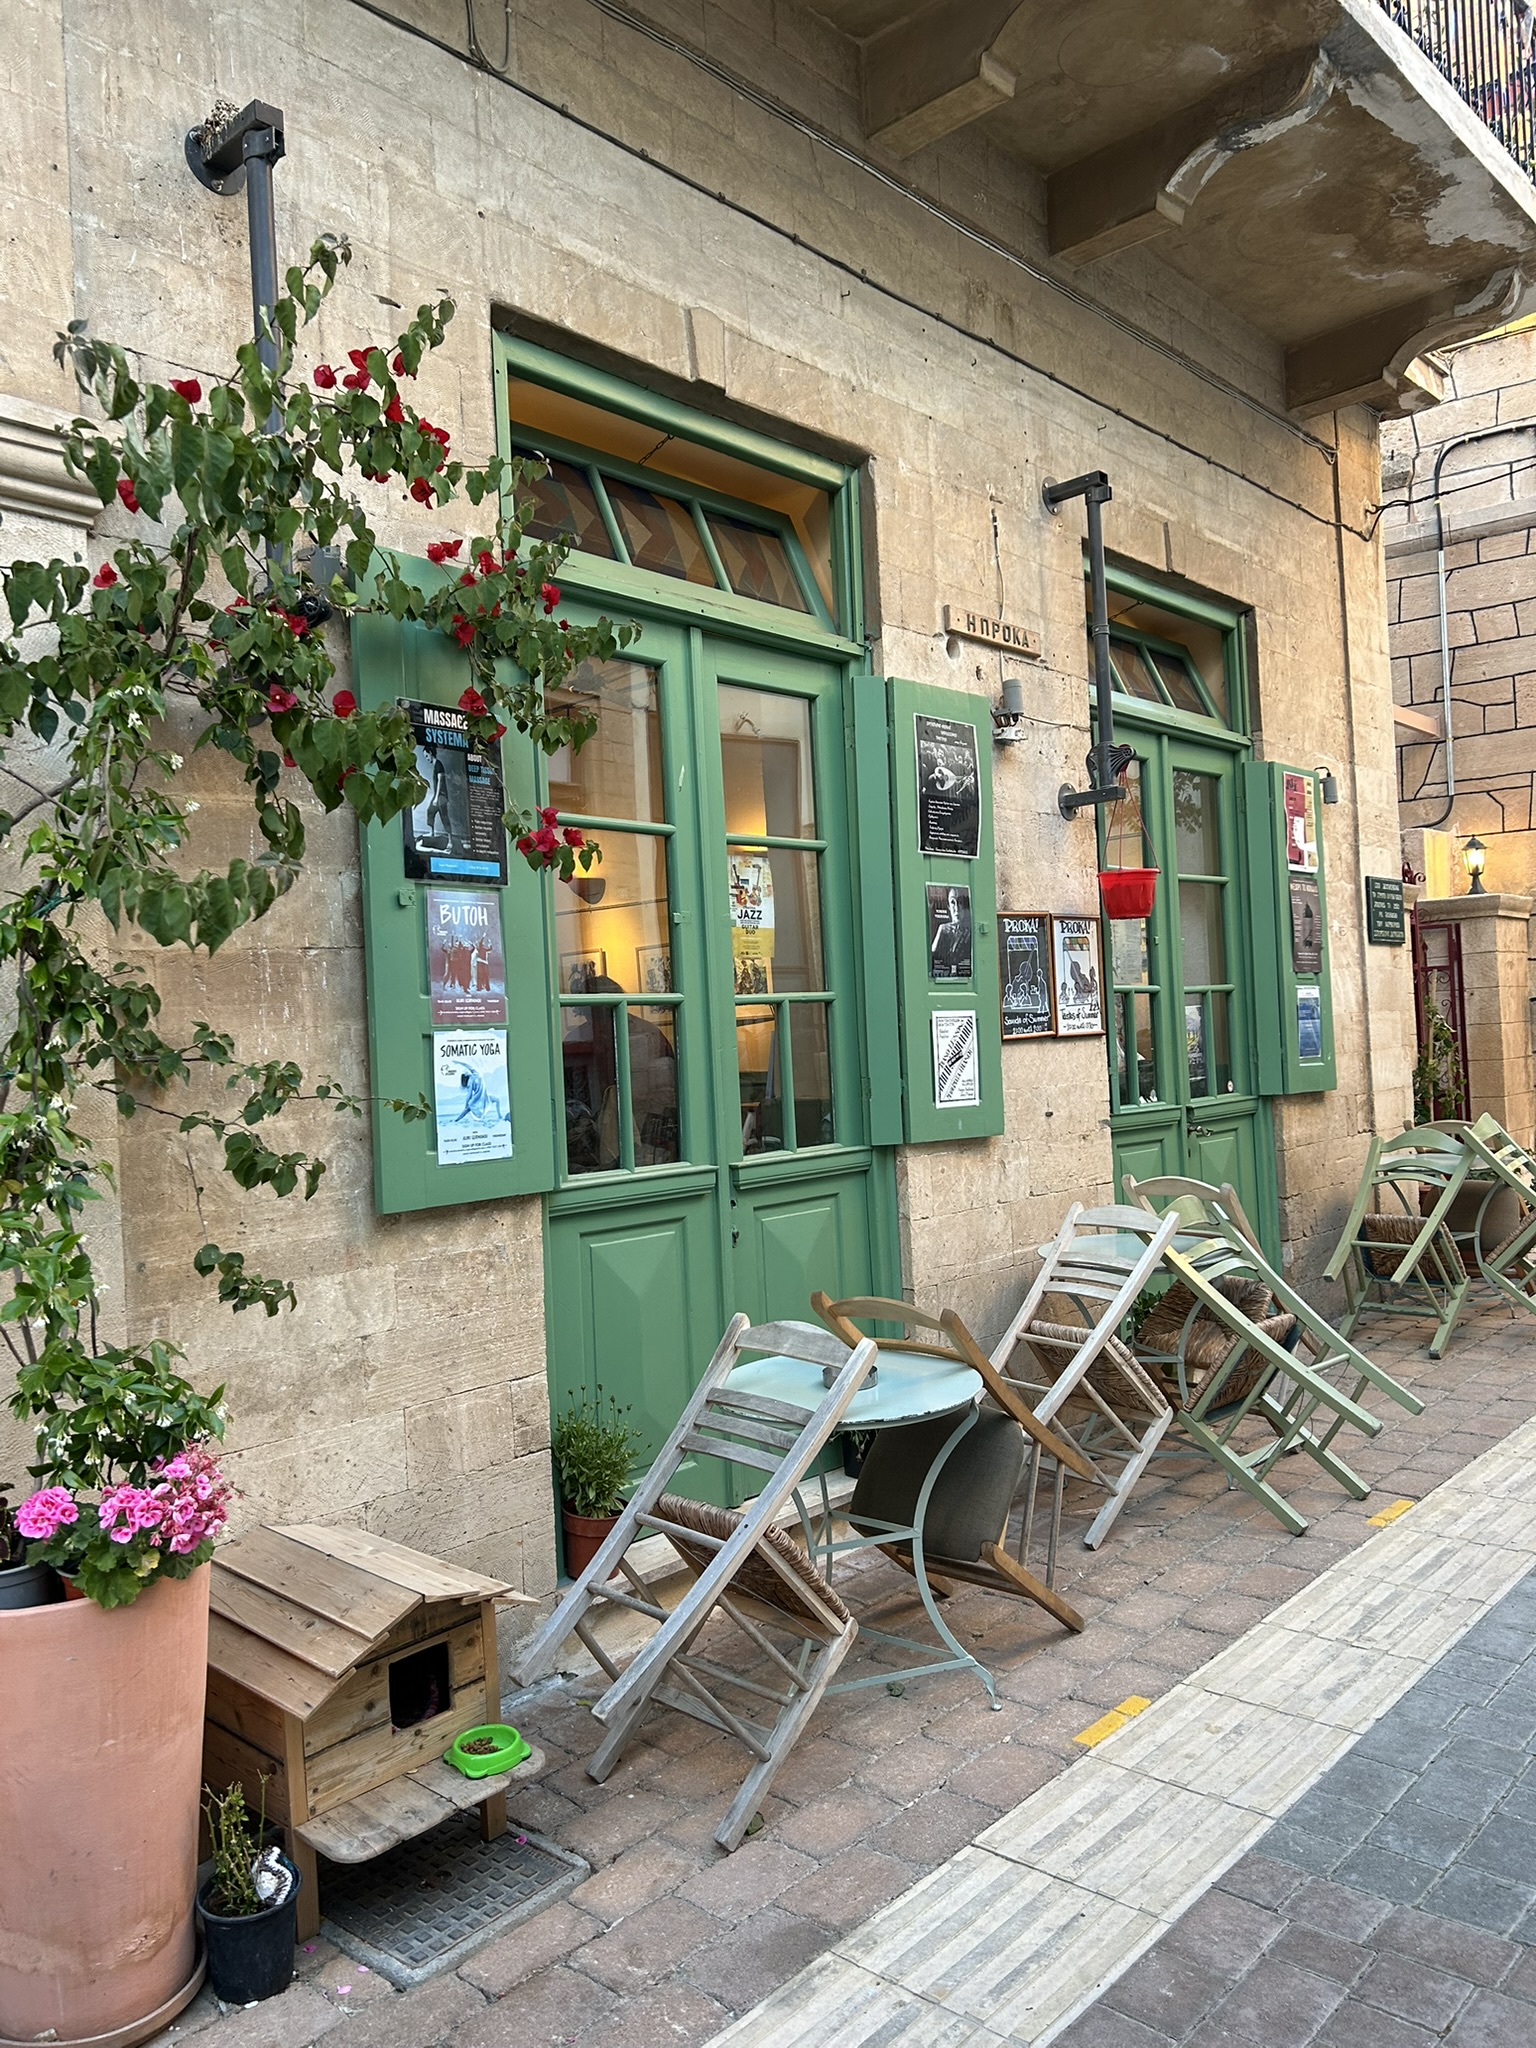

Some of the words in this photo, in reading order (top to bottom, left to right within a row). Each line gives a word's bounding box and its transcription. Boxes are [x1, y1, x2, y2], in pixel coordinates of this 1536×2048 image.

[440, 904, 488, 926] BUTOH
[738, 910, 762, 920] JAZZ
[1003, 918, 1039, 933] PROKA!
[1060, 920, 1091, 935] PROKA!
[1023, 1013, 1028, 1025] of
[1076, 1008, 1081, 1022] of
[440, 1043, 477, 1057] SOMATIC
[480, 1043, 500, 1056] YOGA
